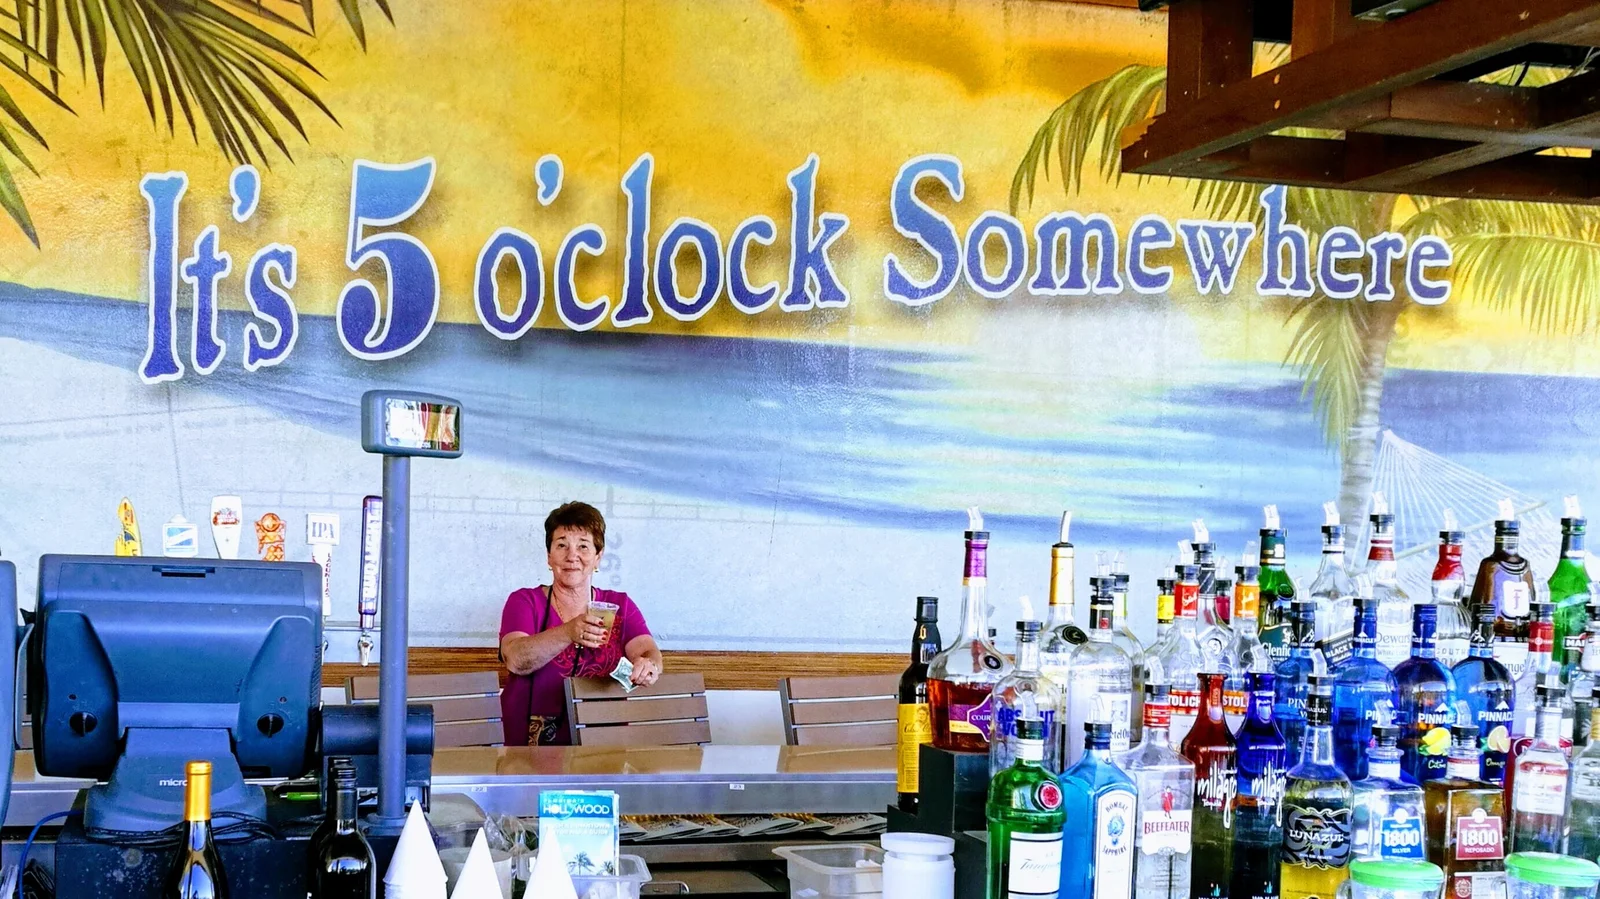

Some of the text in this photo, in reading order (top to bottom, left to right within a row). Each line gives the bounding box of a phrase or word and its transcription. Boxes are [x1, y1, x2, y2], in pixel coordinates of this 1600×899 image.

[138, 152, 1453, 384] It's 5 o'clock Somewhere
[311, 521, 335, 539] IPA
[1325, 645, 1348, 659] BLACK
[1197, 760, 1238, 829] milagro
[543, 803, 611, 815] HOLLYWOOD
[1144, 821, 1190, 835] BEEFEATER
[1289, 829, 1344, 843] LUNAZUL
[1383, 828, 1420, 847] 1800
[1461, 828, 1499, 847] 1800
